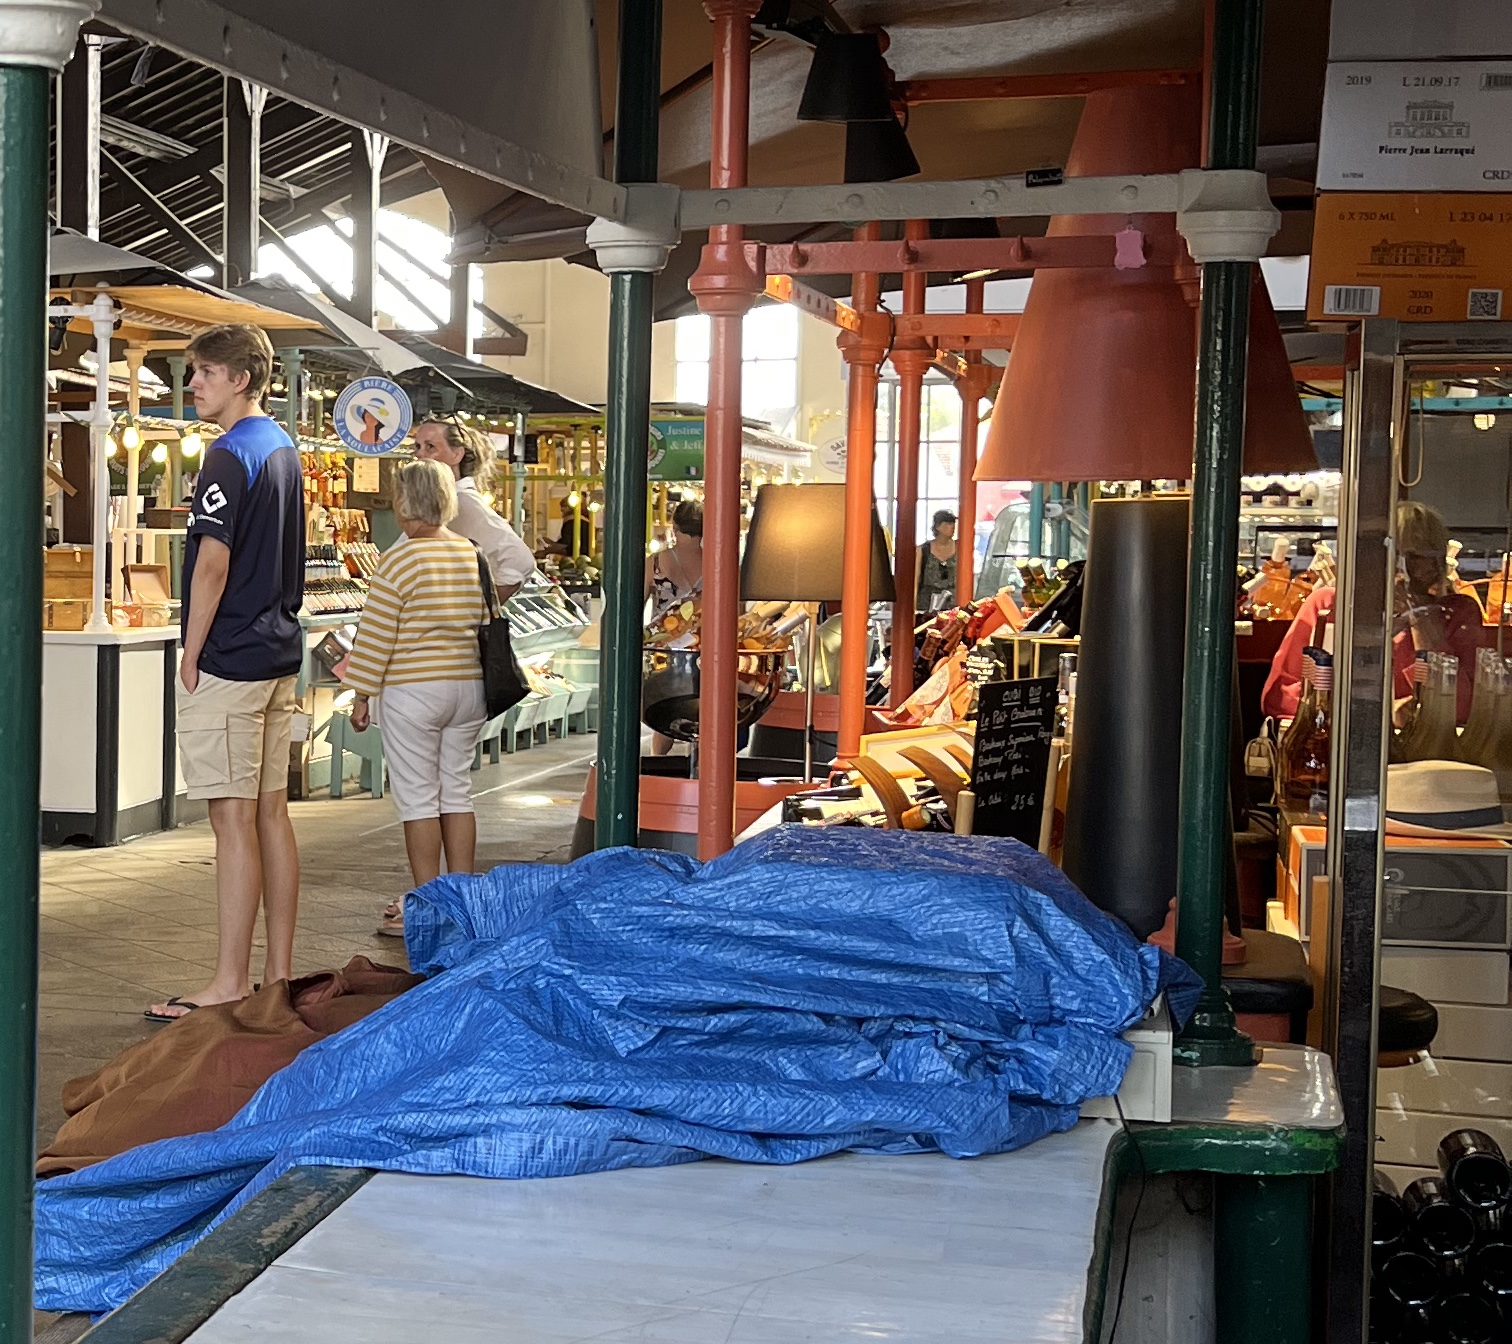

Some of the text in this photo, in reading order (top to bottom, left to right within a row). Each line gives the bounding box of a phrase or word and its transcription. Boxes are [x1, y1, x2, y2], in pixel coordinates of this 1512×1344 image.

[1346, 75, 1372, 86] 2019
[1402, 77, 1410, 87] L
[1378, 145, 1475, 157] Pierre Jean Larraqué
[667, 425, 702, 435] Justine
